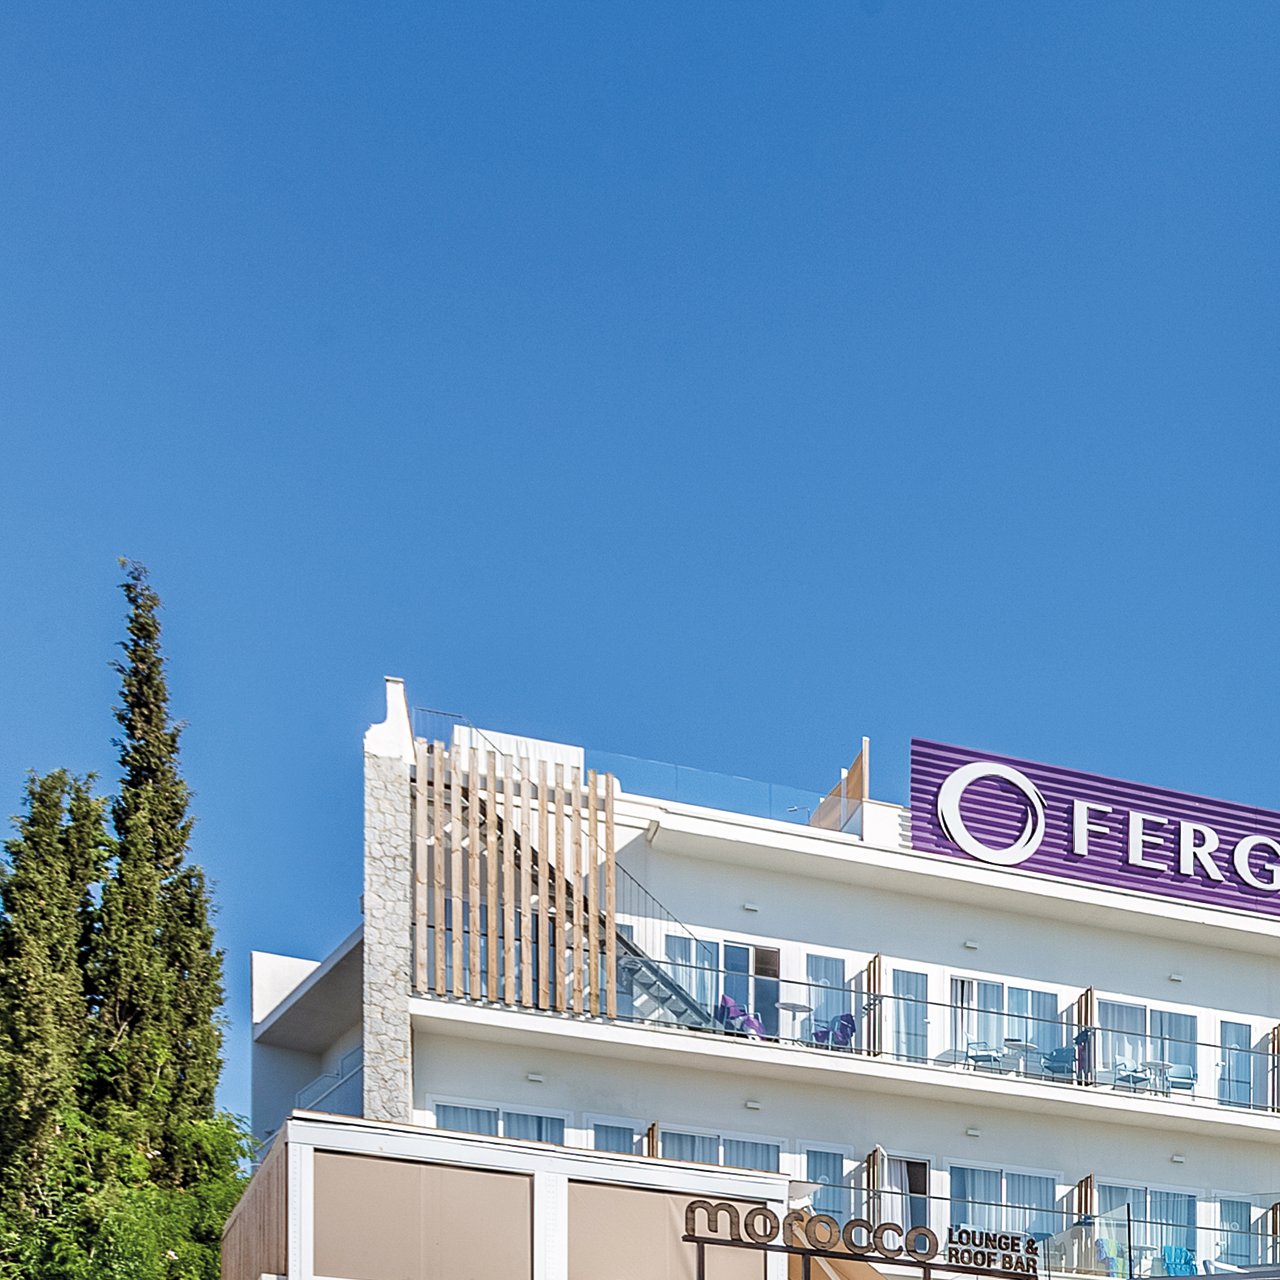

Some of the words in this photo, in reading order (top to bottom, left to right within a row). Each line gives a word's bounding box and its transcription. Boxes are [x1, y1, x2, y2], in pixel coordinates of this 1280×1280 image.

[685, 1200, 939, 1262] morocco
[948, 1227, 1021, 1253] LOUNGE
[1026, 1237, 1039, 1257] &
[948, 1249, 997, 1268] ROOF
[1002, 1254, 1038, 1274] BAR
